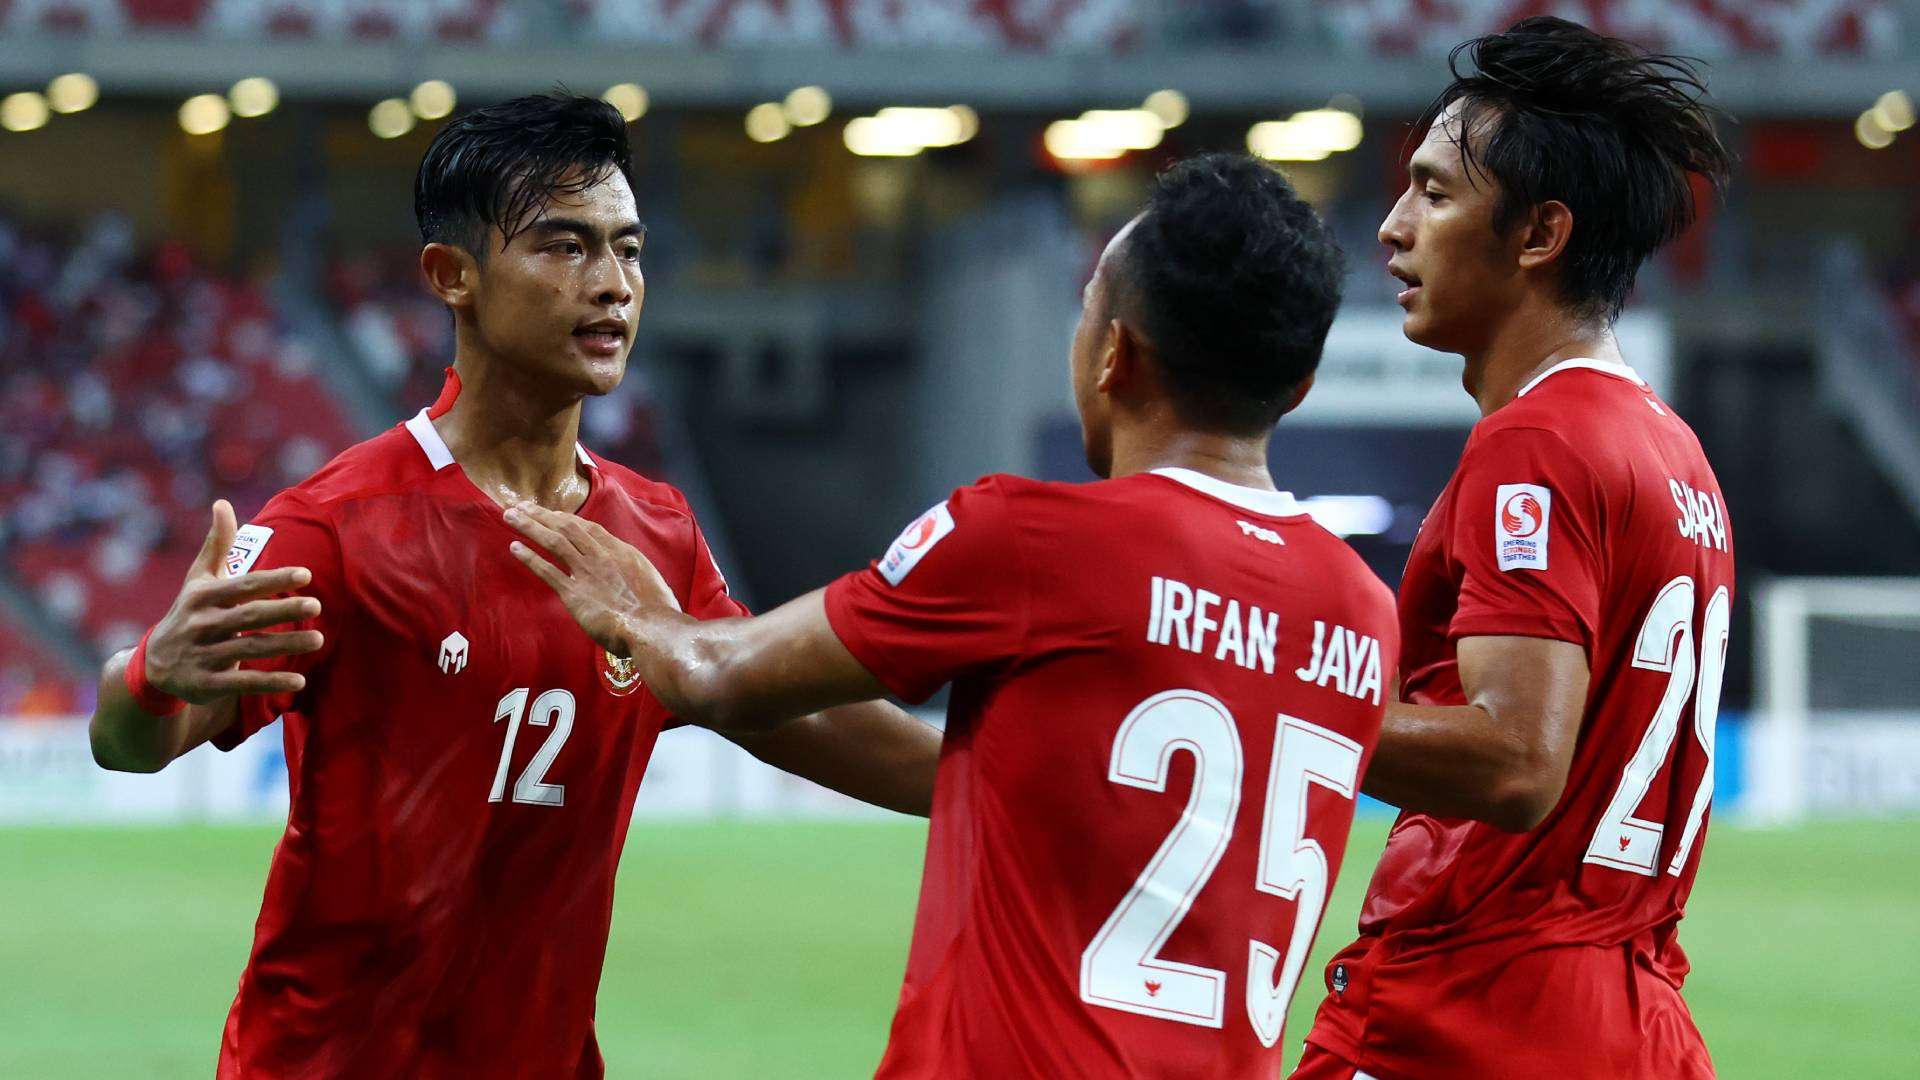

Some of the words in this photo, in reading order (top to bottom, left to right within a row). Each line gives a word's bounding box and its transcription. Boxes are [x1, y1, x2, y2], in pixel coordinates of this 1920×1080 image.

[1147, 576, 1280, 675] IRFAN
[1295, 620, 1382, 707] JAYA
[487, 687, 576, 807] 12
[1080, 688, 1364, 1049] 25
